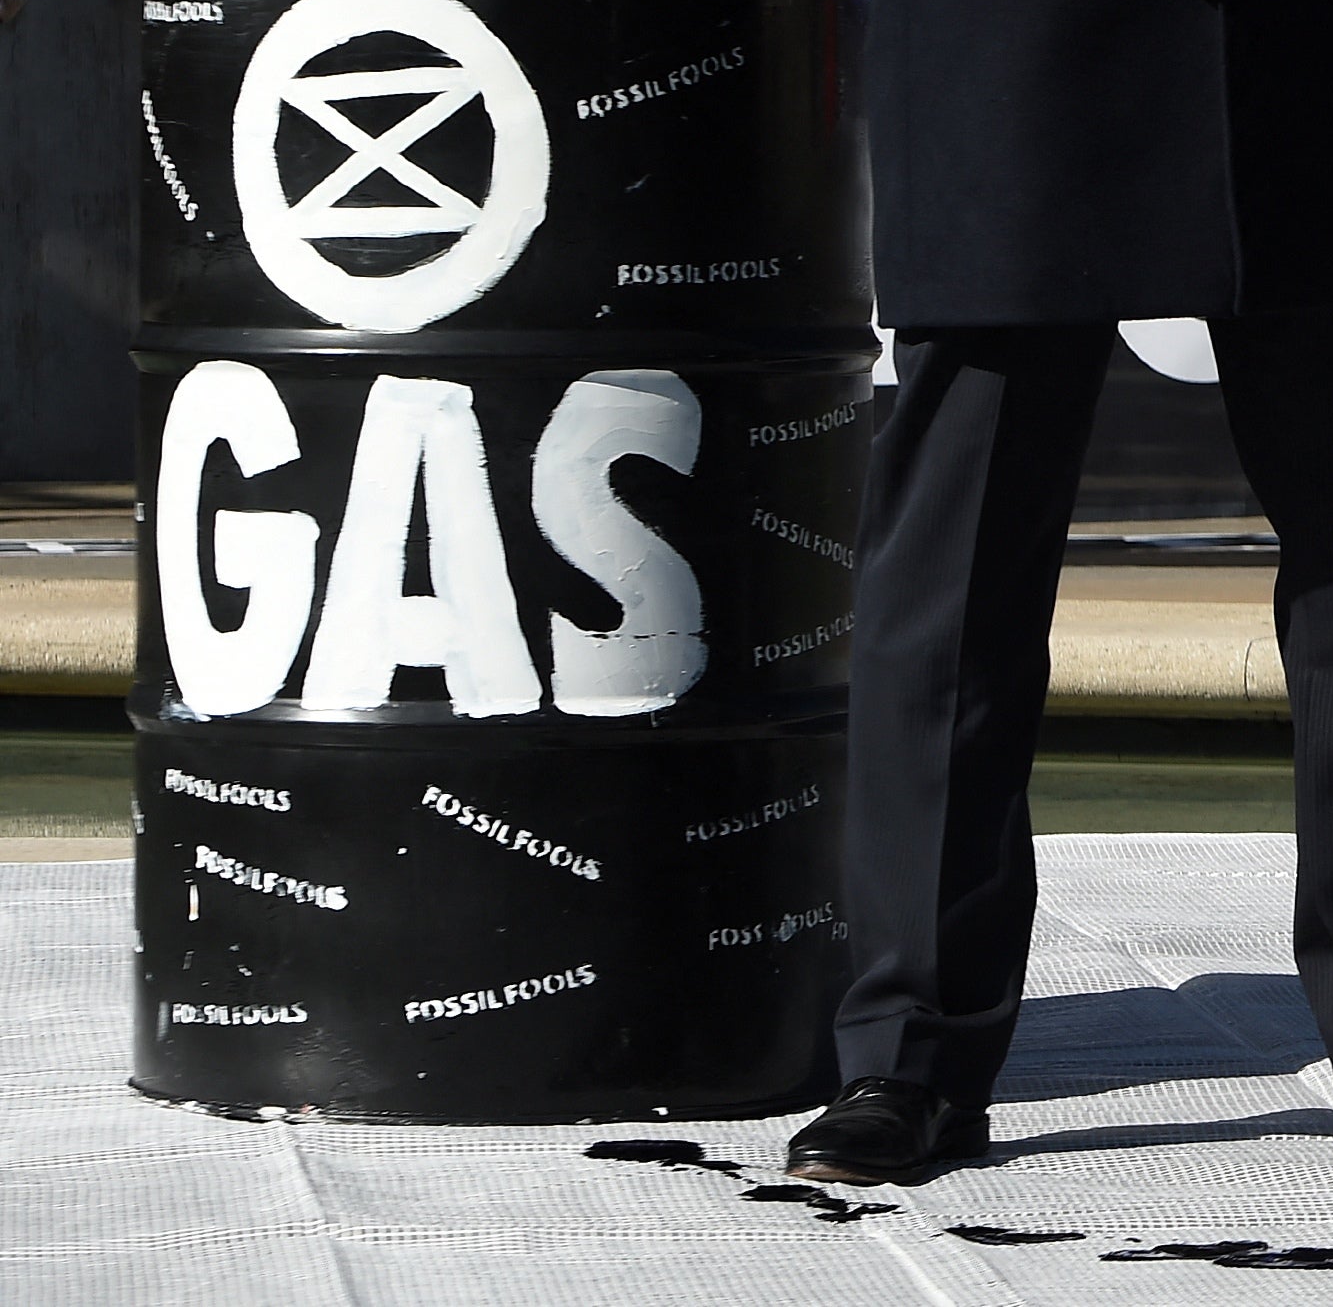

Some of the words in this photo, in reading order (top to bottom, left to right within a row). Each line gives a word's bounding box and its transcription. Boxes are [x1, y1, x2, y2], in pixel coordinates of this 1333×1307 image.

[617, 264, 705, 285] FOSSIL
[709, 258, 781, 282] FOOLS
[750, 420, 812, 447] FOSSIL
[156, 360, 708, 720] GAS
[751, 508, 812, 550] FOSSIL
[754, 633, 815, 667] FOSSIL
[421, 786, 510, 845] FOSSIL
[508, 829, 602, 880] FOOLS
[404, 989, 503, 1024] FOSSIL
[502, 964, 597, 1005] FOOLS
